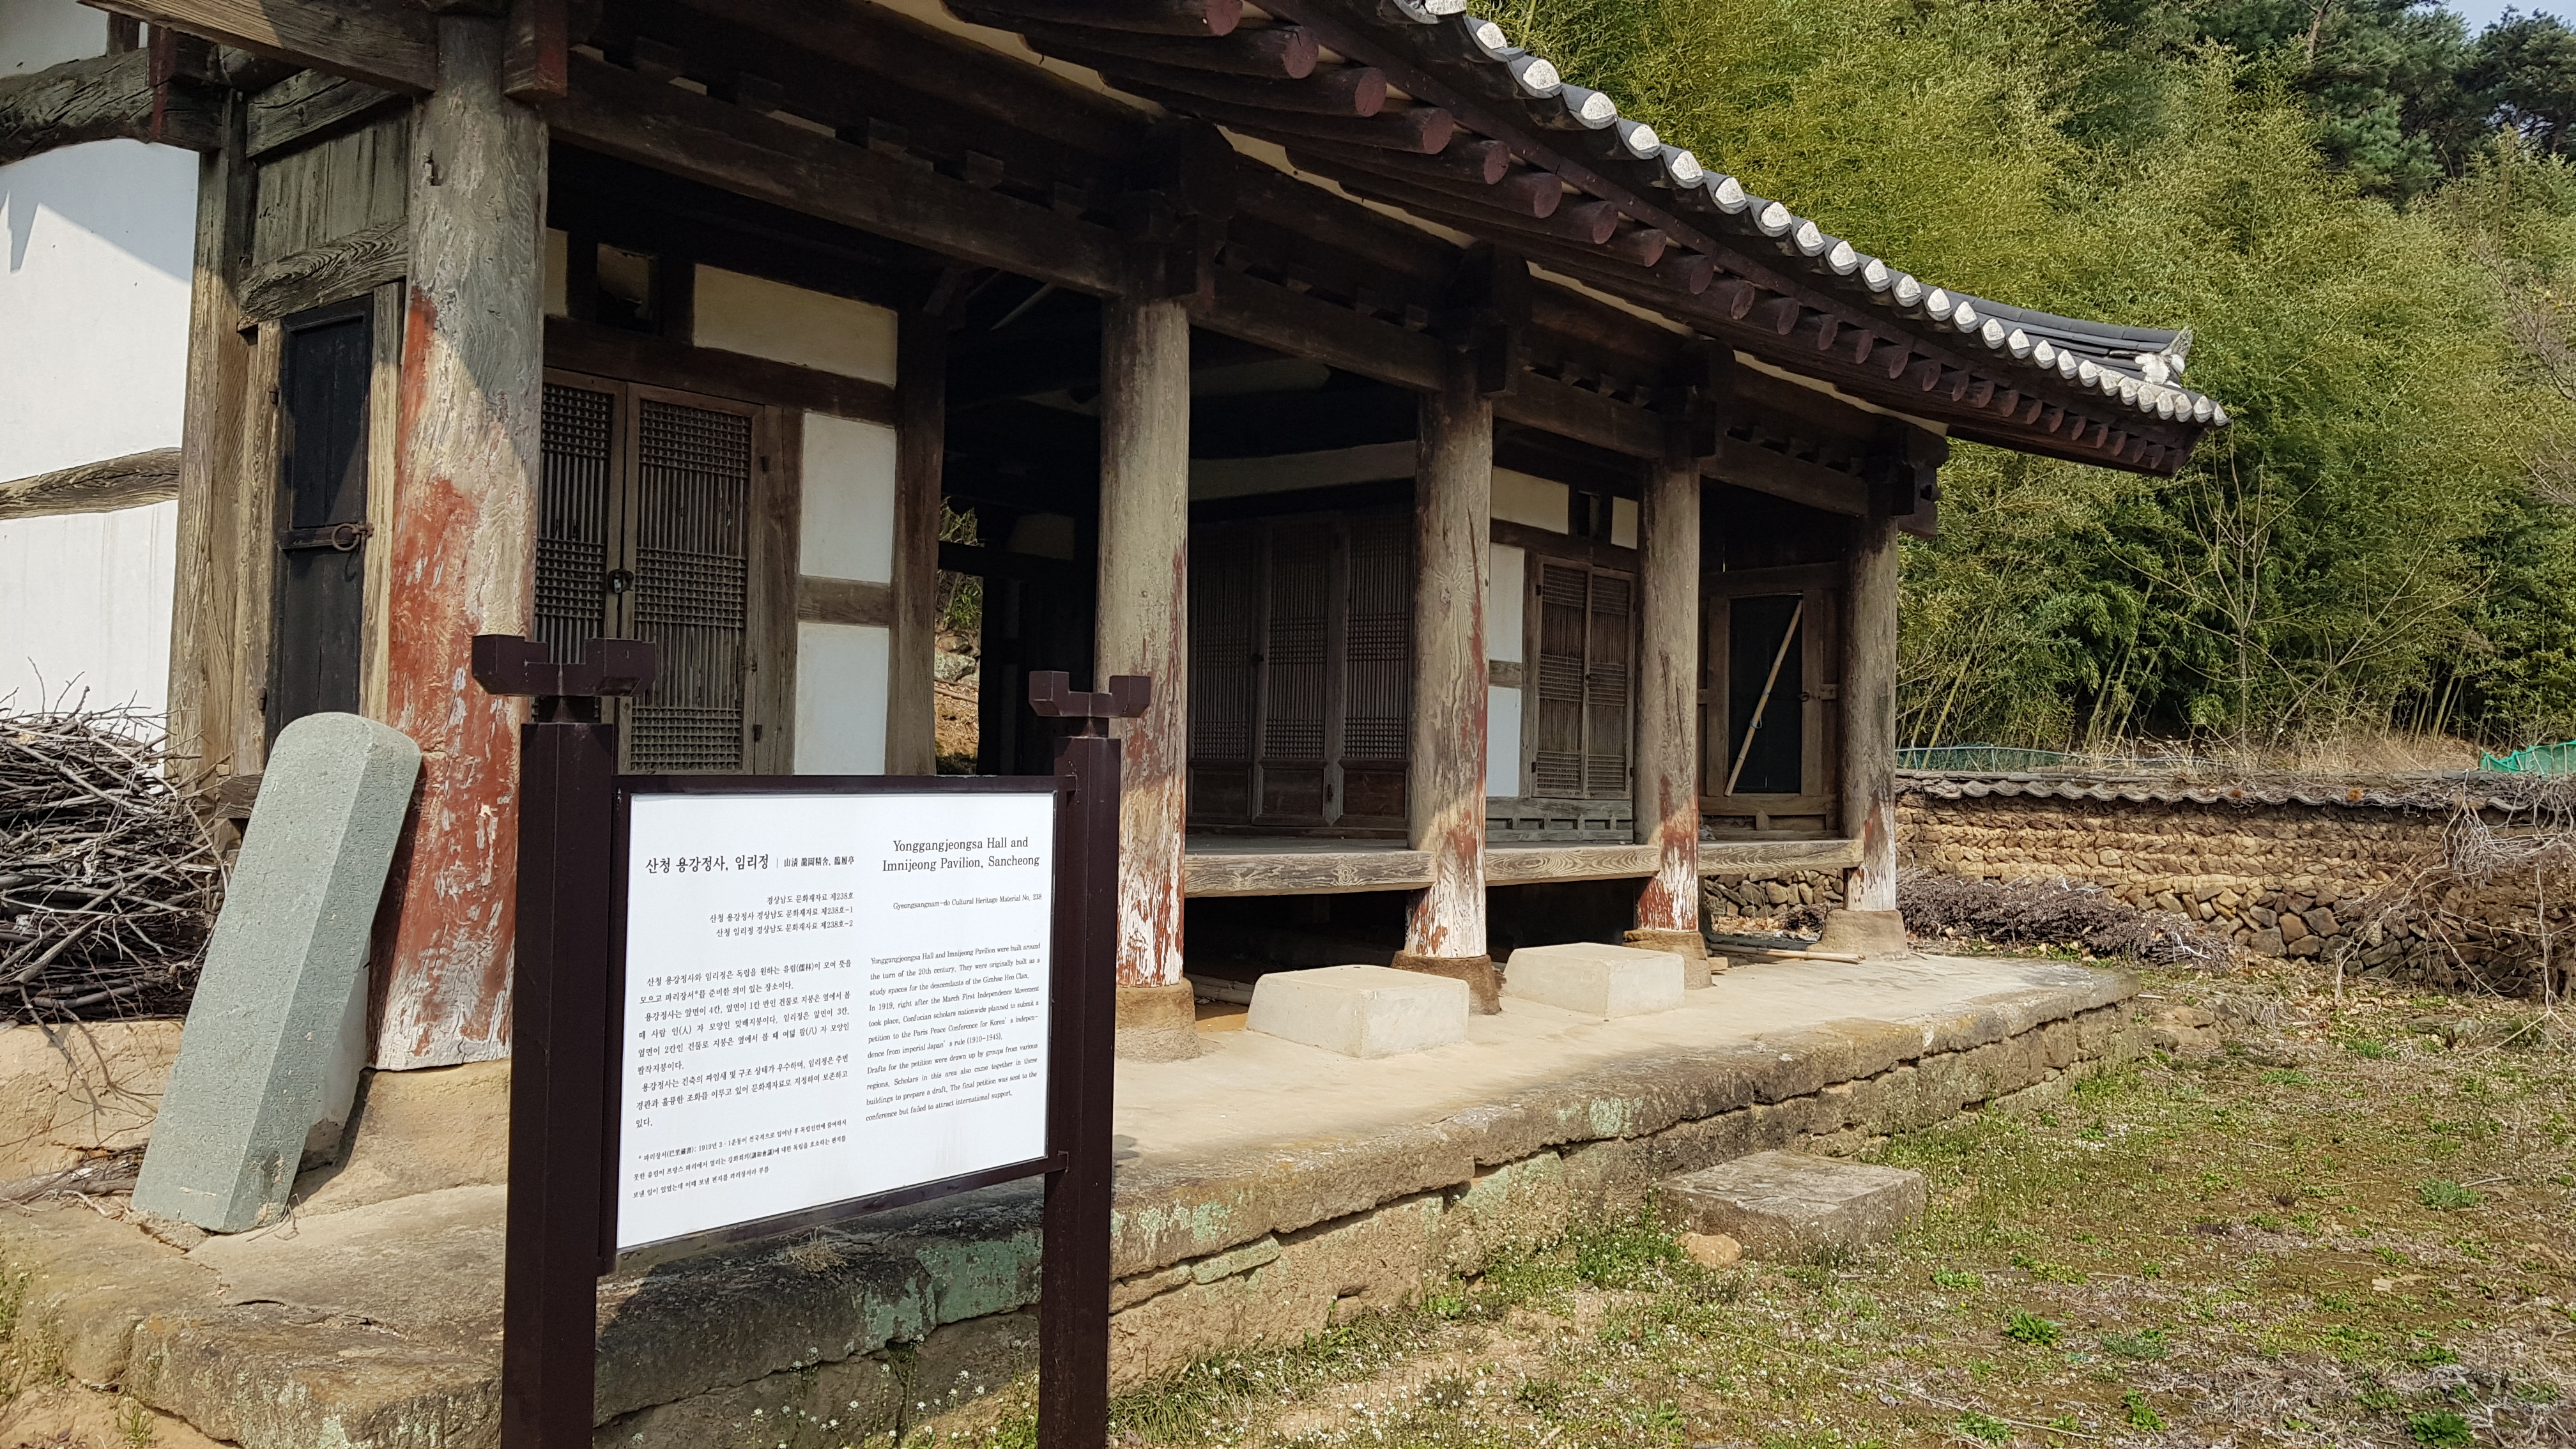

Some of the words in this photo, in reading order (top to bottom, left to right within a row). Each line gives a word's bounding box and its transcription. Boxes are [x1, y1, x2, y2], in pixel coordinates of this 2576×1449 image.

[893, 838, 983, 854] Yonggangjeongsa
[986, 836, 1008, 848] Hall
[1010, 836, 1029, 848] and
[645, 857, 670, 874] 산청
[675, 855, 728, 873] 용강정사,
[735, 854, 769, 871] 임리정
[882, 859, 937, 873] Imnijeong
[940, 856, 984, 869] Pavilion,
[988, 854, 1040, 867] Sancheong
[767, 895, 793, 905] 경상남도
[795, 893, 828, 903] 문화재자료
[830, 892, 854, 901] 제238호
[893, 899, 951, 910] Gyeongsangnam-do
[951, 897, 974, 906] Cultural
[999, 894, 1021, 903] Material
[709, 913, 724, 923] 산청
[726, 911, 755, 923] 용강정사
[756, 910, 784, 921] 경상남도
[786, 907, 819, 918] 문화재자료
[820, 906, 853, 916] 제238호-1
[716, 927, 730, 938] 산청
[733, 926, 753, 937] 임리정
[756, 924, 783, 935] 경상남도
[785, 921, 818, 932] 문화재자료
[820, 919, 853, 930] 제238호-2
[922, 952, 934, 960] Hall
[935, 951, 946, 959] and
[1023, 942, 1041, 951] around
[870, 972, 880, 981] the
[918, 967, 931, 976] 20th
[989, 959, 1014, 969] originally
[870, 987, 886, 996] study
[887, 986, 908, 995] spaces
[930, 979, 964, 989] descendants
[983, 975, 1003, 983] Gimhae
[898, 1000, 912, 1009] right
[942, 994, 960, 1003] March
[868, 1018, 882, 1027] took
[903, 1013, 931, 1023] Confucian
[933, 1010, 956, 1019] scholars
[988, 1002, 1009, 1013] planned
[868, 1034, 891, 1045] petition
[913, 1028, 928, 1037] Paris
[947, 1023, 978, 1032] Conference
[902, 1043, 926, 1054] imperial
[954, 1038, 965, 1046] rule
[867, 1065, 886, 1075] Drafts
[888, 1063, 898, 1071] for
[910, 1059, 932, 1069] petition
[977, 1050, 985, 1059] by
[894, 1076, 919, 1085] Scholars
[931, 1071, 942, 1080] this
[866, 1096, 894, 1106] buildings
[903, 1091, 925, 1101] prepare
[962, 1080, 975, 1089] final
[865, 1111, 898, 1121] conference
[899, 1107, 909, 1116] but
[910, 1103, 926, 1114] failed
[935, 1100, 954, 1109] attract
[955, 1092, 990, 1105] international
[699, 1142, 717, 1152] 1919년
